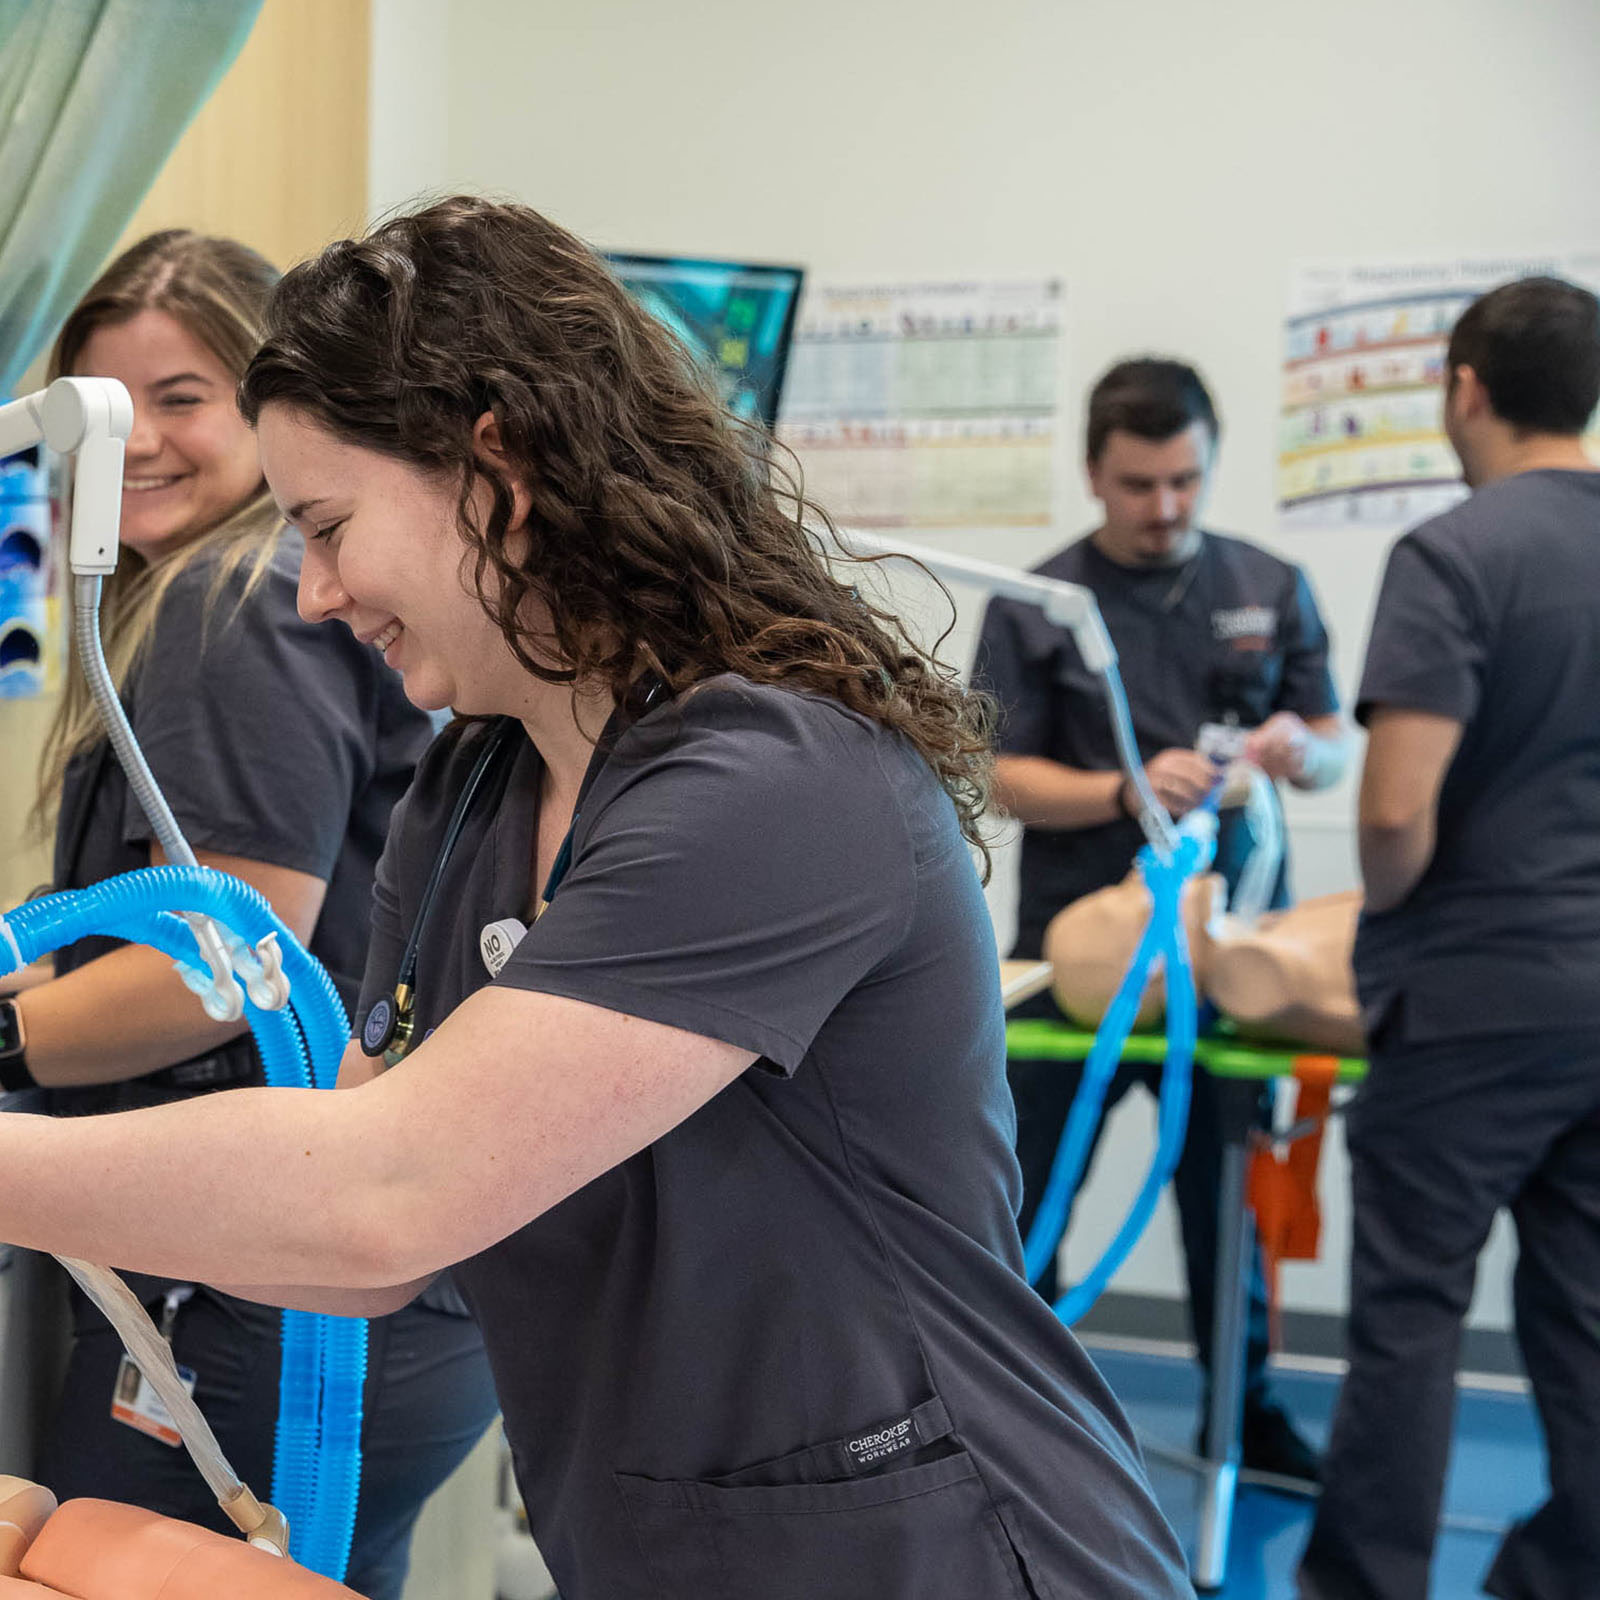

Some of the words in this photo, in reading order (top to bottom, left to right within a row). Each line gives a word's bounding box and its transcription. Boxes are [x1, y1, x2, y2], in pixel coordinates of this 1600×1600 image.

[483, 934, 501, 958] NO
[849, 1419, 910, 1452] CHEROKEE
[858, 1438, 911, 1463] WORKWEAR
